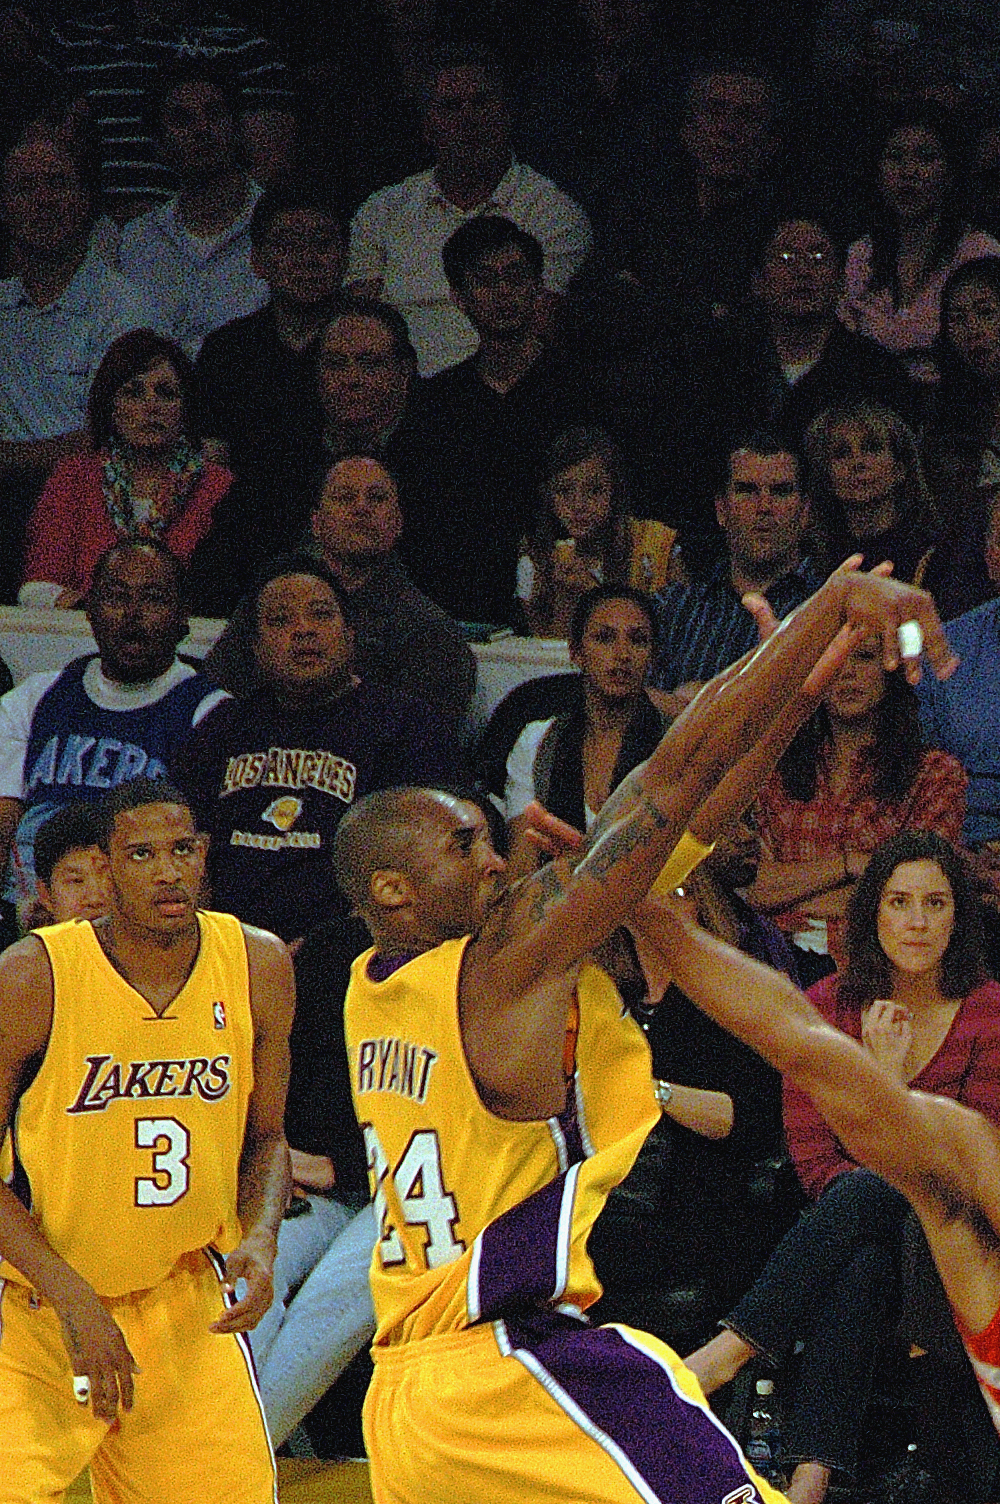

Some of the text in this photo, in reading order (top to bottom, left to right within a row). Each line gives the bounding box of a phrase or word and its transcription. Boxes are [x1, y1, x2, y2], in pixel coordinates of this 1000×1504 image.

[219, 746, 357, 804] LOS ANGELES
[65, 1054, 230, 1115] LAKERS
[357, 1038, 438, 1104] RYANT
[134, 1116, 191, 1207] 3
